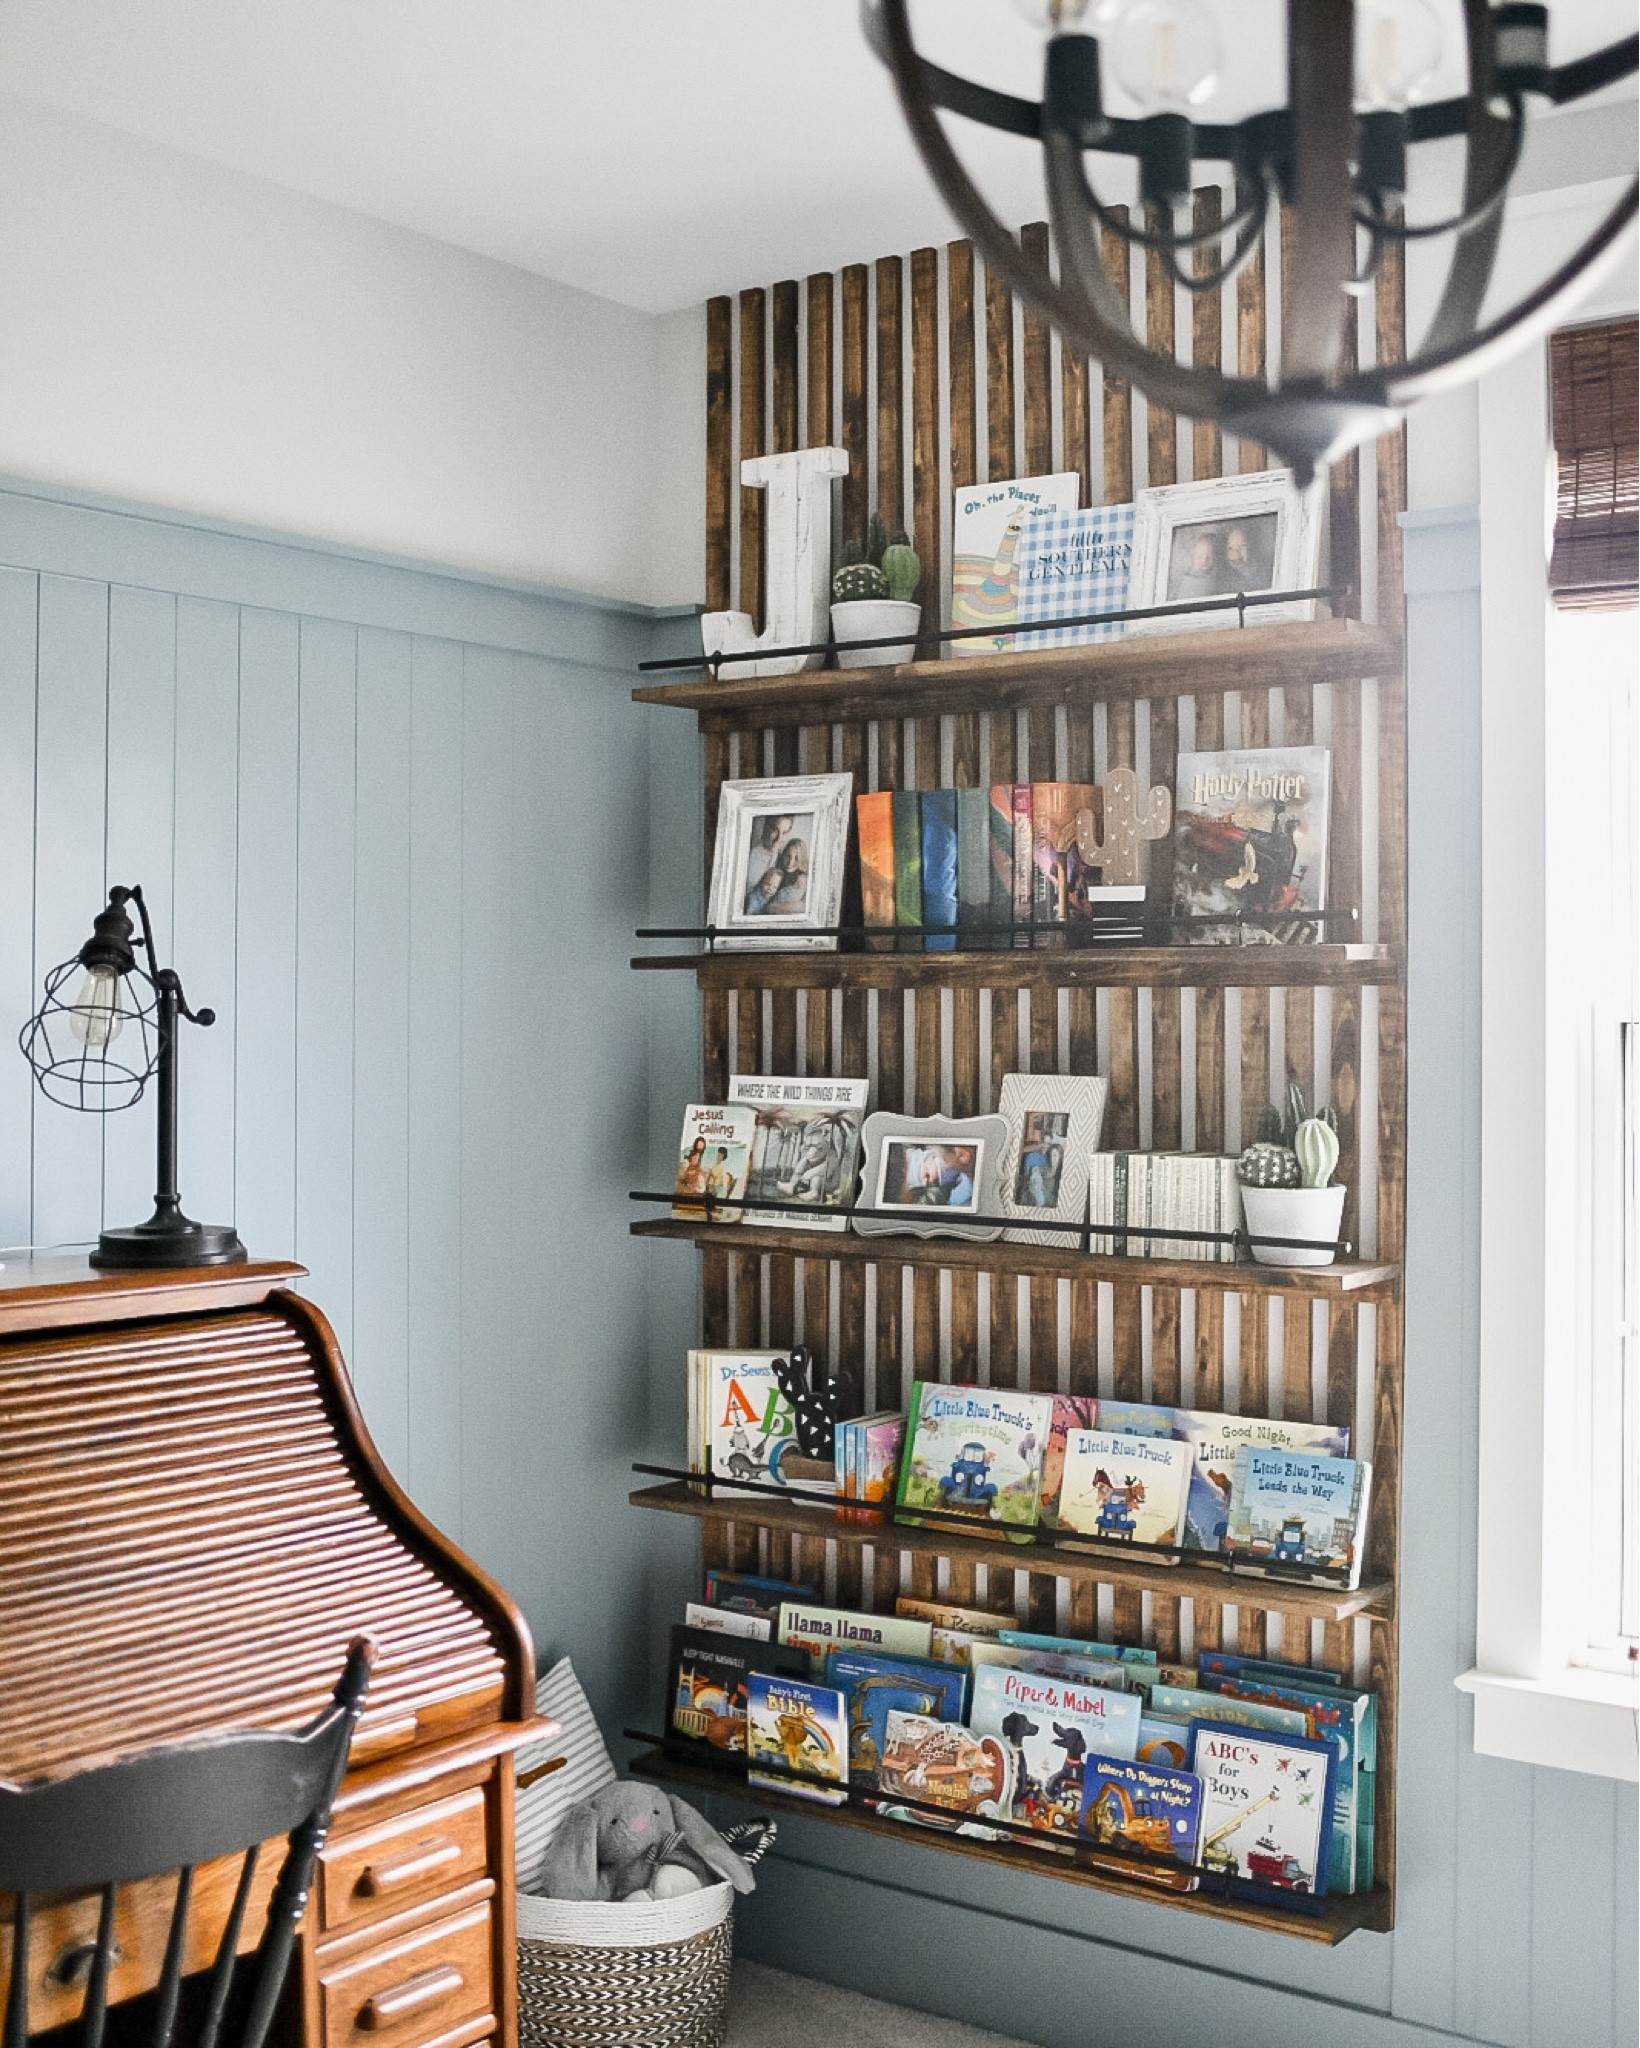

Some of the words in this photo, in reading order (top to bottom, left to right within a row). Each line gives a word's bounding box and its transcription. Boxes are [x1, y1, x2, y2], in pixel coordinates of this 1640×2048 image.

[987, 493, 1004, 506] the
[1008, 486, 1041, 505] Places
[1070, 530, 1104, 548] little
[1028, 559, 1129, 581] GENTLEMA
[1191, 770, 1245, 807] Harry
[1247, 766, 1305, 804] Potter
[737, 1082, 766, 1098] WHERE
[767, 1083, 781, 1099] THE
[782, 1085, 802, 1101] WILD
[804, 1086, 834, 1102] THINGS
[835, 1086, 853, 1102] ARE
[692, 1109, 725, 1122] Jesus
[699, 1123, 735, 1139] Calling
[720, 1366, 740, 1382] Dr.
[740, 1362, 779, 1378] Seuss
[934, 1399, 963, 1418] Little
[966, 1399, 991, 1419] Blue
[992, 1403, 1034, 1432] Truck's
[1222, 1424, 1253, 1439] Good
[1078, 1437, 1109, 1454] Little
[1111, 1440, 1137, 1457] Blue
[1138, 1443, 1173, 1466] Truck
[1198, 1441, 1237, 1462] Little
[1252, 1458, 1283, 1475] Little
[1284, 1461, 1310, 1479] Blue
[1311, 1464, 1346, 1486] Truck
[1257, 1478, 1288, 1493] Leads
[1292, 1480, 1308, 1496] the
[1310, 1484, 1335, 1502] Way
[787, 1612, 833, 1637] llama
[837, 1619, 883, 1645] llama
[785, 1633, 822, 1656] time
[766, 1692, 816, 1717] Bible
[1004, 1675, 1044, 1703] Piper
[1044, 1686, 1059, 1708] &
[1063, 1690, 1107, 1718] Mabel
[1204, 1740, 1260, 1766] ABC's
[1097, 1762, 1125, 1778] Where
[1125, 1766, 1137, 1781] Do
[1138, 1770, 1169, 1788] Diggers
[1169, 1777, 1192, 1795] Sleep
[1218, 1762, 1241, 1779] for
[927, 1779, 969, 1800] Noah's
[1161, 1790, 1192, 1807] Night?
[1208, 1776, 1250, 1801] Boys
